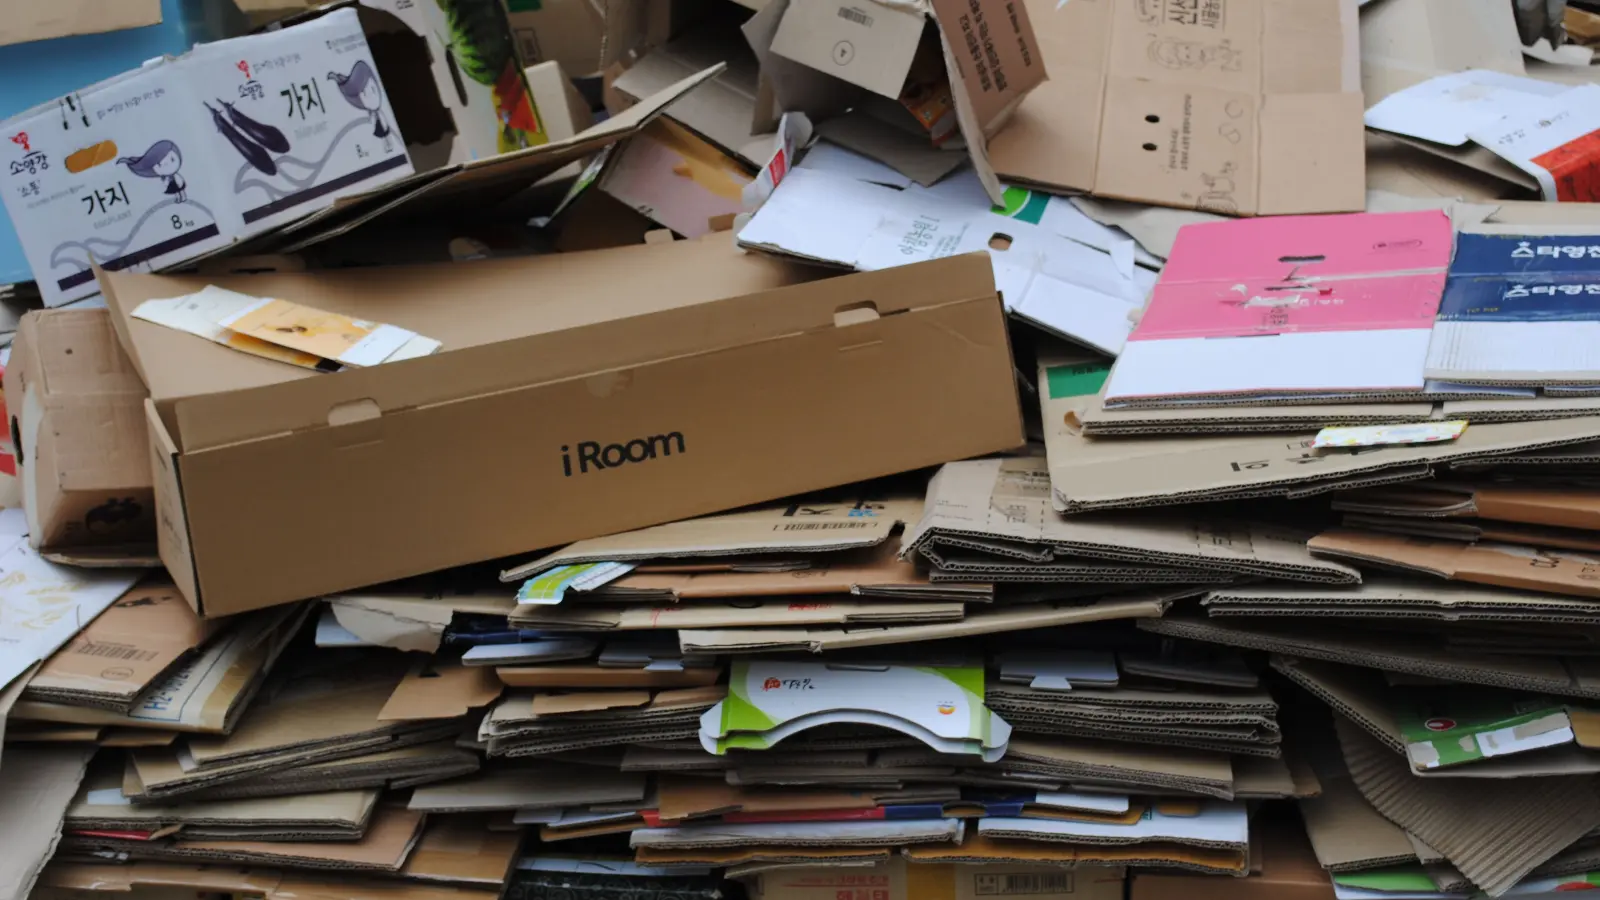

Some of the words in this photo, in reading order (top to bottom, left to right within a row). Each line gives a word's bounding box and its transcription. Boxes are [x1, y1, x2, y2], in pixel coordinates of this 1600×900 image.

[280, 77, 326, 121] 가지
[10, 150, 49, 176] 소양강
[81, 181, 130, 215] 가지
[170, 214, 182, 230] 8
